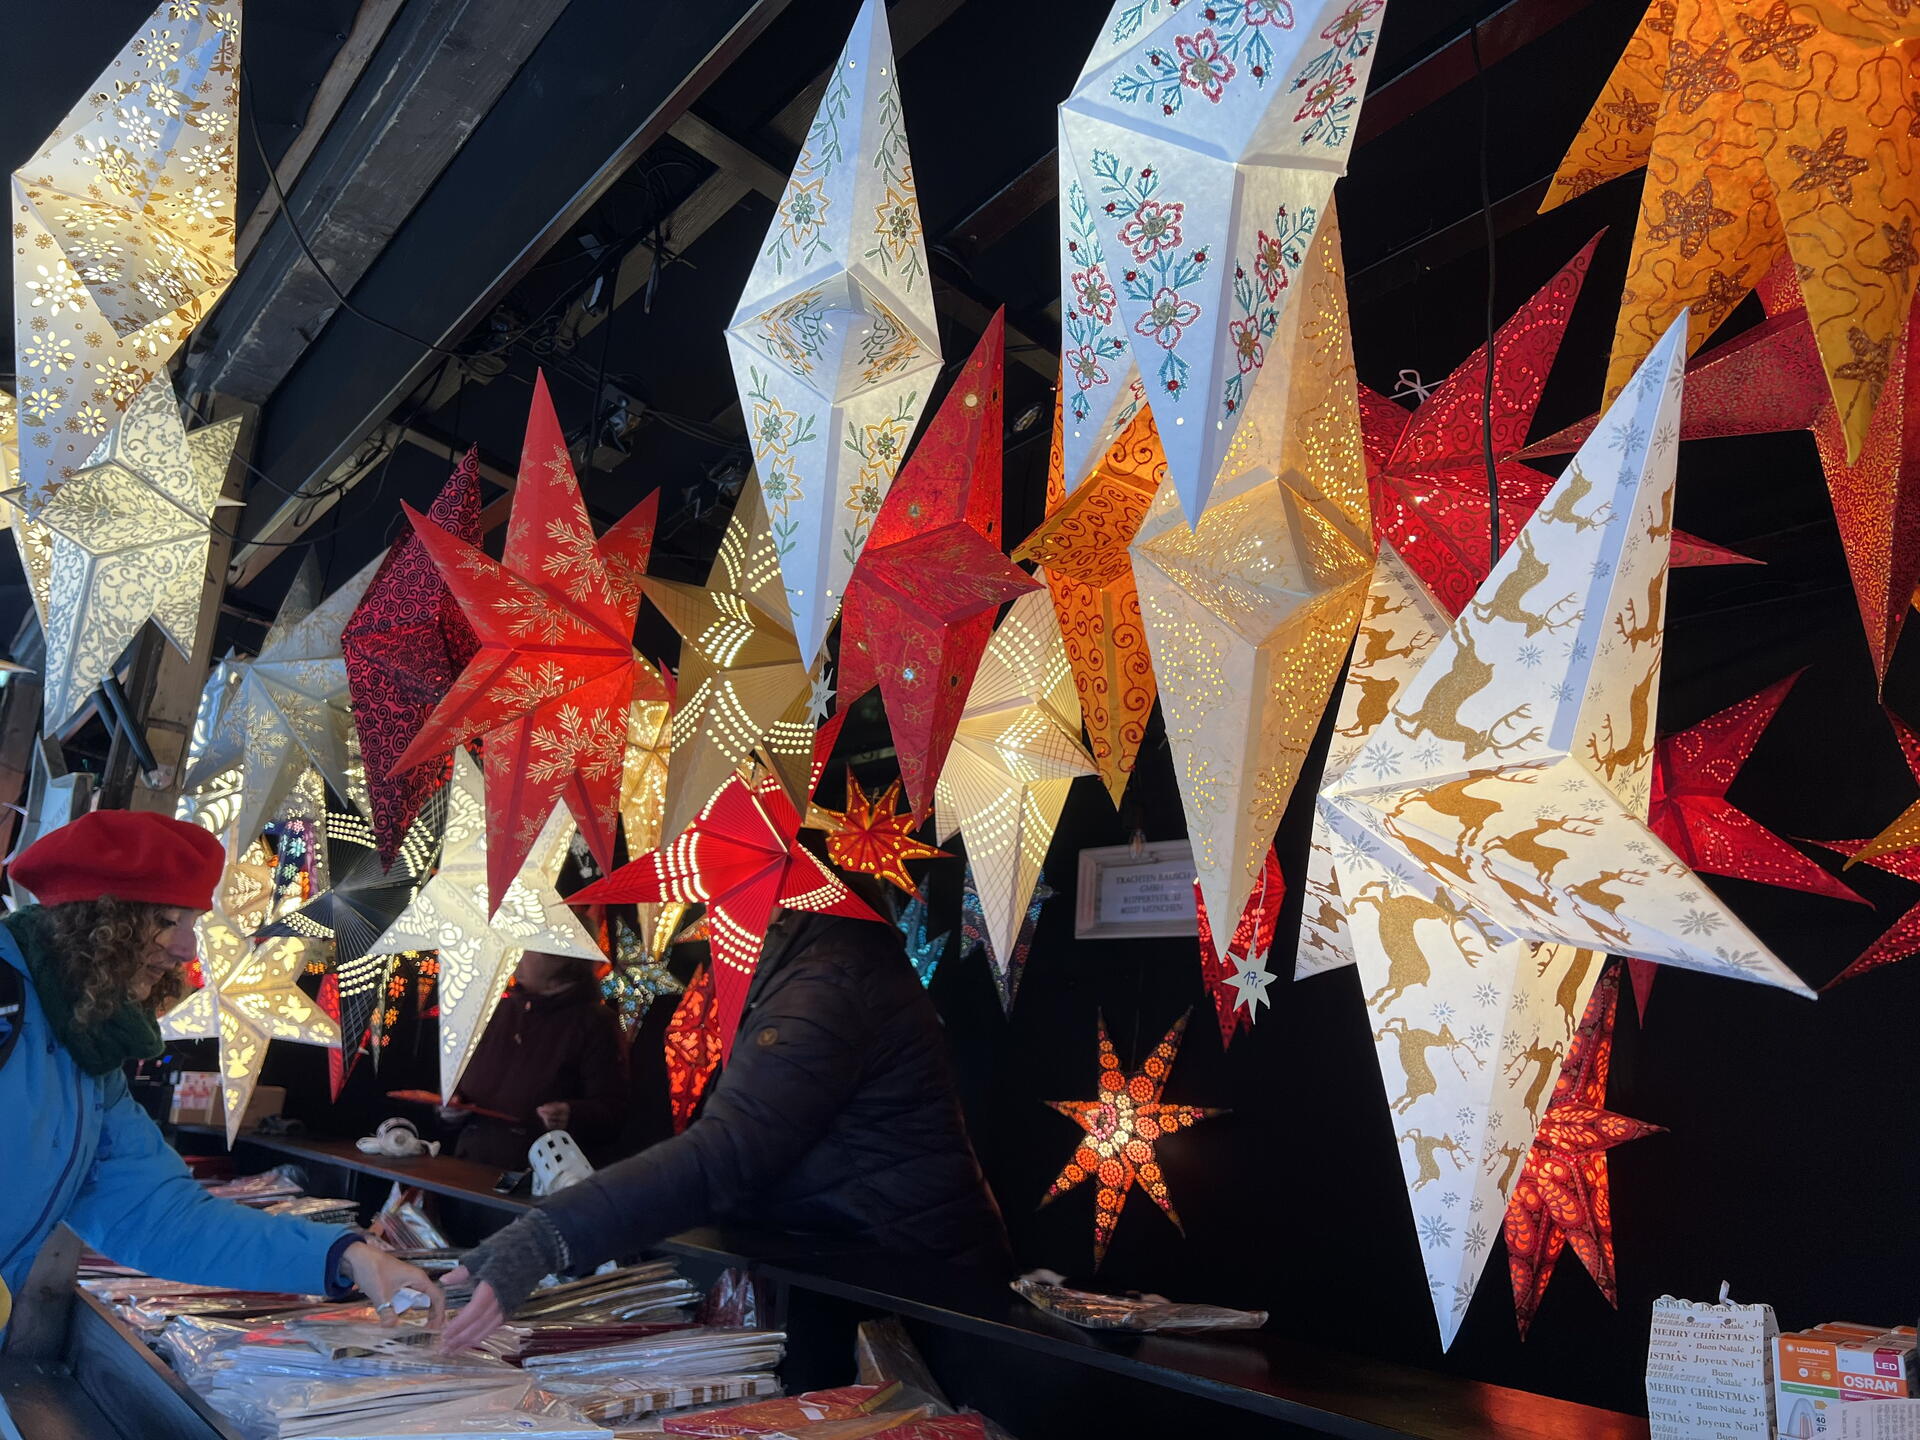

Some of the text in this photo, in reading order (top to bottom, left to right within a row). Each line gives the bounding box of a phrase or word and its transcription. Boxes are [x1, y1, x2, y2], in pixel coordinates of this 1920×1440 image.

[1653, 1327, 1689, 1338] MERRY
[1693, 1331, 1755, 1342] CHRISTMAS
[1696, 1342, 1717, 1351] Buon
[1718, 1344, 1745, 1353] Natale
[1796, 1347, 1830, 1356] LEDVANCE
[1694, 1355, 1728, 1366] Joyeux
[1731, 1358, 1754, 1369] Noël
[1876, 1362, 1898, 1371] LED
[1711, 1368, 1733, 1378] Buon
[1715, 1377, 1743, 1387] Natale
[1843, 1375, 1898, 1393] OSRAM
[1648, 1382, 1757, 1403] MERRY CHRISTMAS
[1696, 1401, 1718, 1412] Buon
[1719, 1404, 1747, 1415] Natale
[1696, 1416, 1732, 1428] Joyeux
[1734, 1420, 1759, 1433] Noël
[1816, 1416, 1826, 1424] 40
